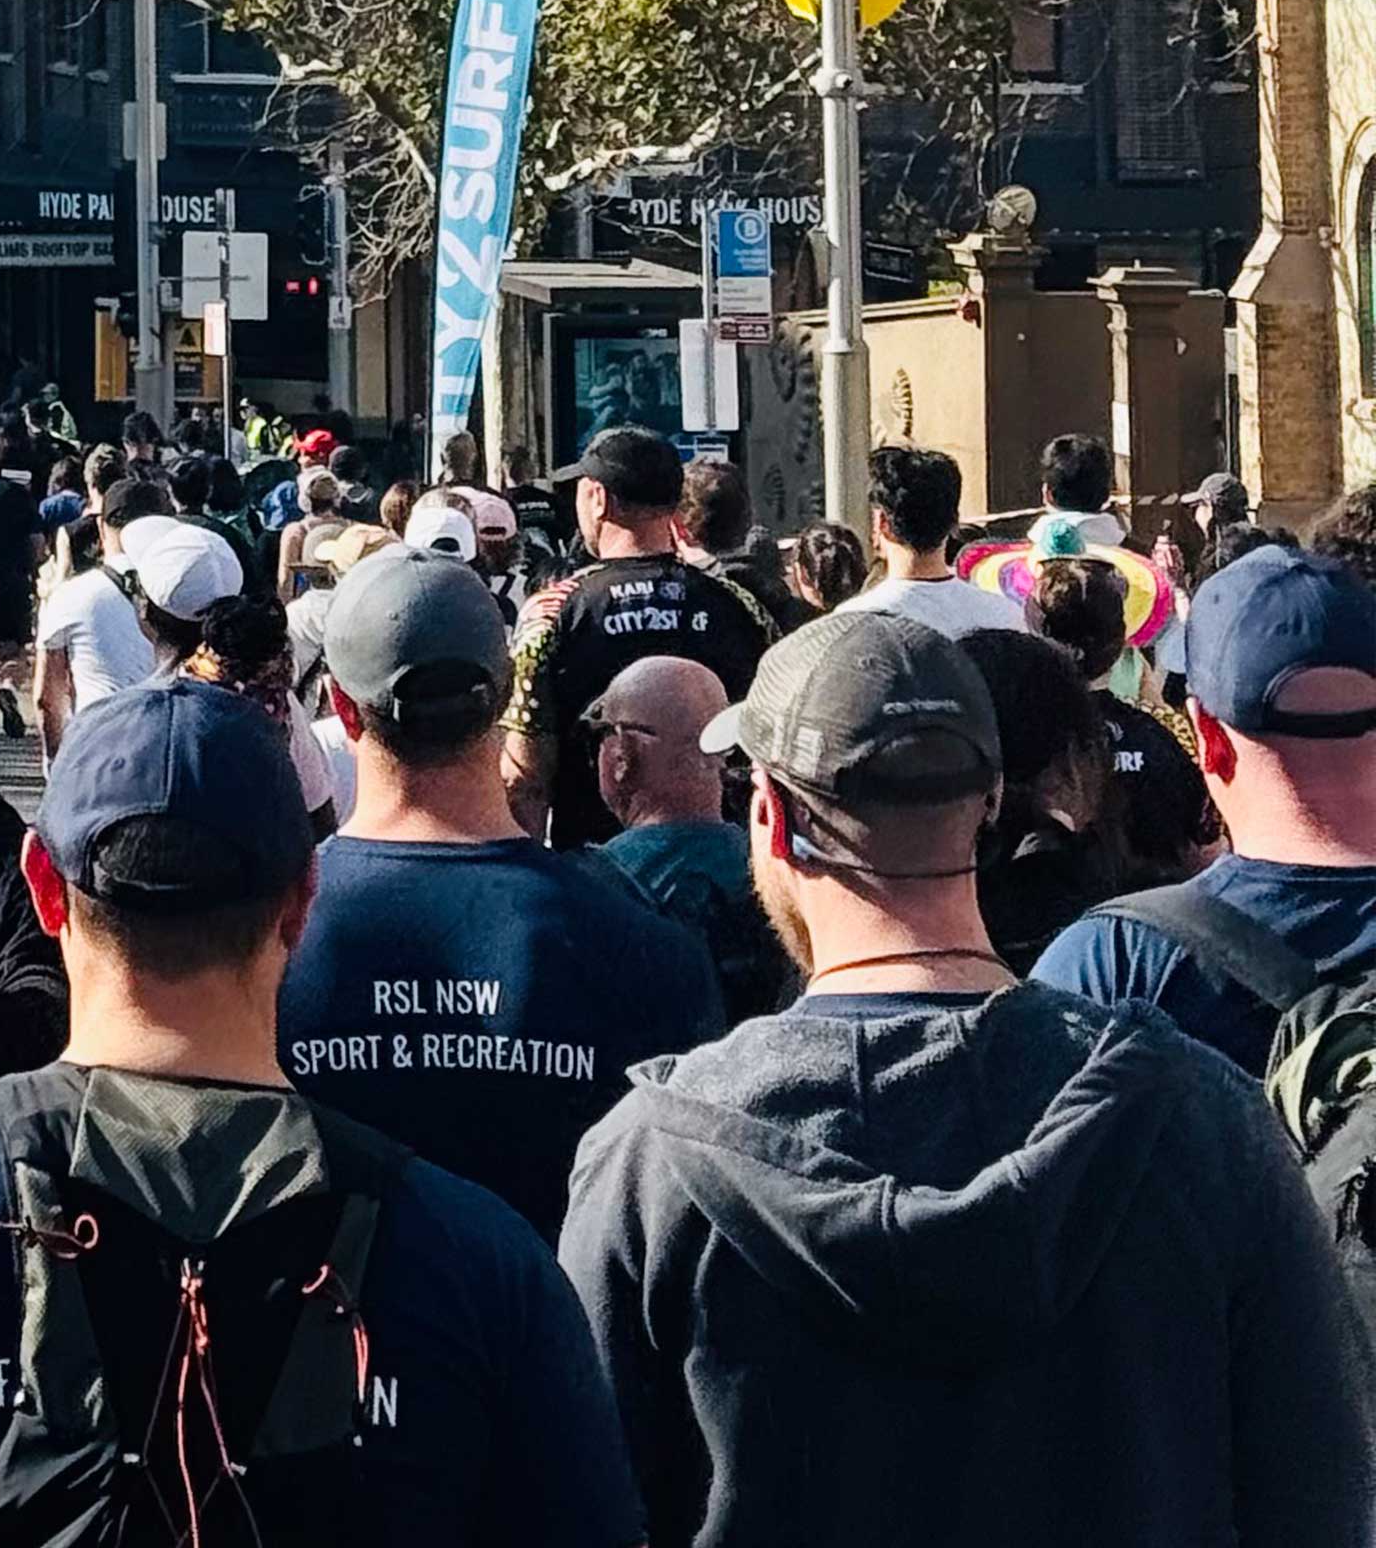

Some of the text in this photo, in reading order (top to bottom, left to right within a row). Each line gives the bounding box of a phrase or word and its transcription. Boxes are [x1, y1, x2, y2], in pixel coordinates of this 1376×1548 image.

[38, 190, 216, 224] HYDE PA OUSE
[757, 195, 823, 226] HOUS
[31, 241, 90, 256] ROOFTOP
[92, 242, 114, 256] BA
[372, 979, 502, 1017] RSL NSW
[291, 1033, 595, 1082] SPORT & RECREATION
